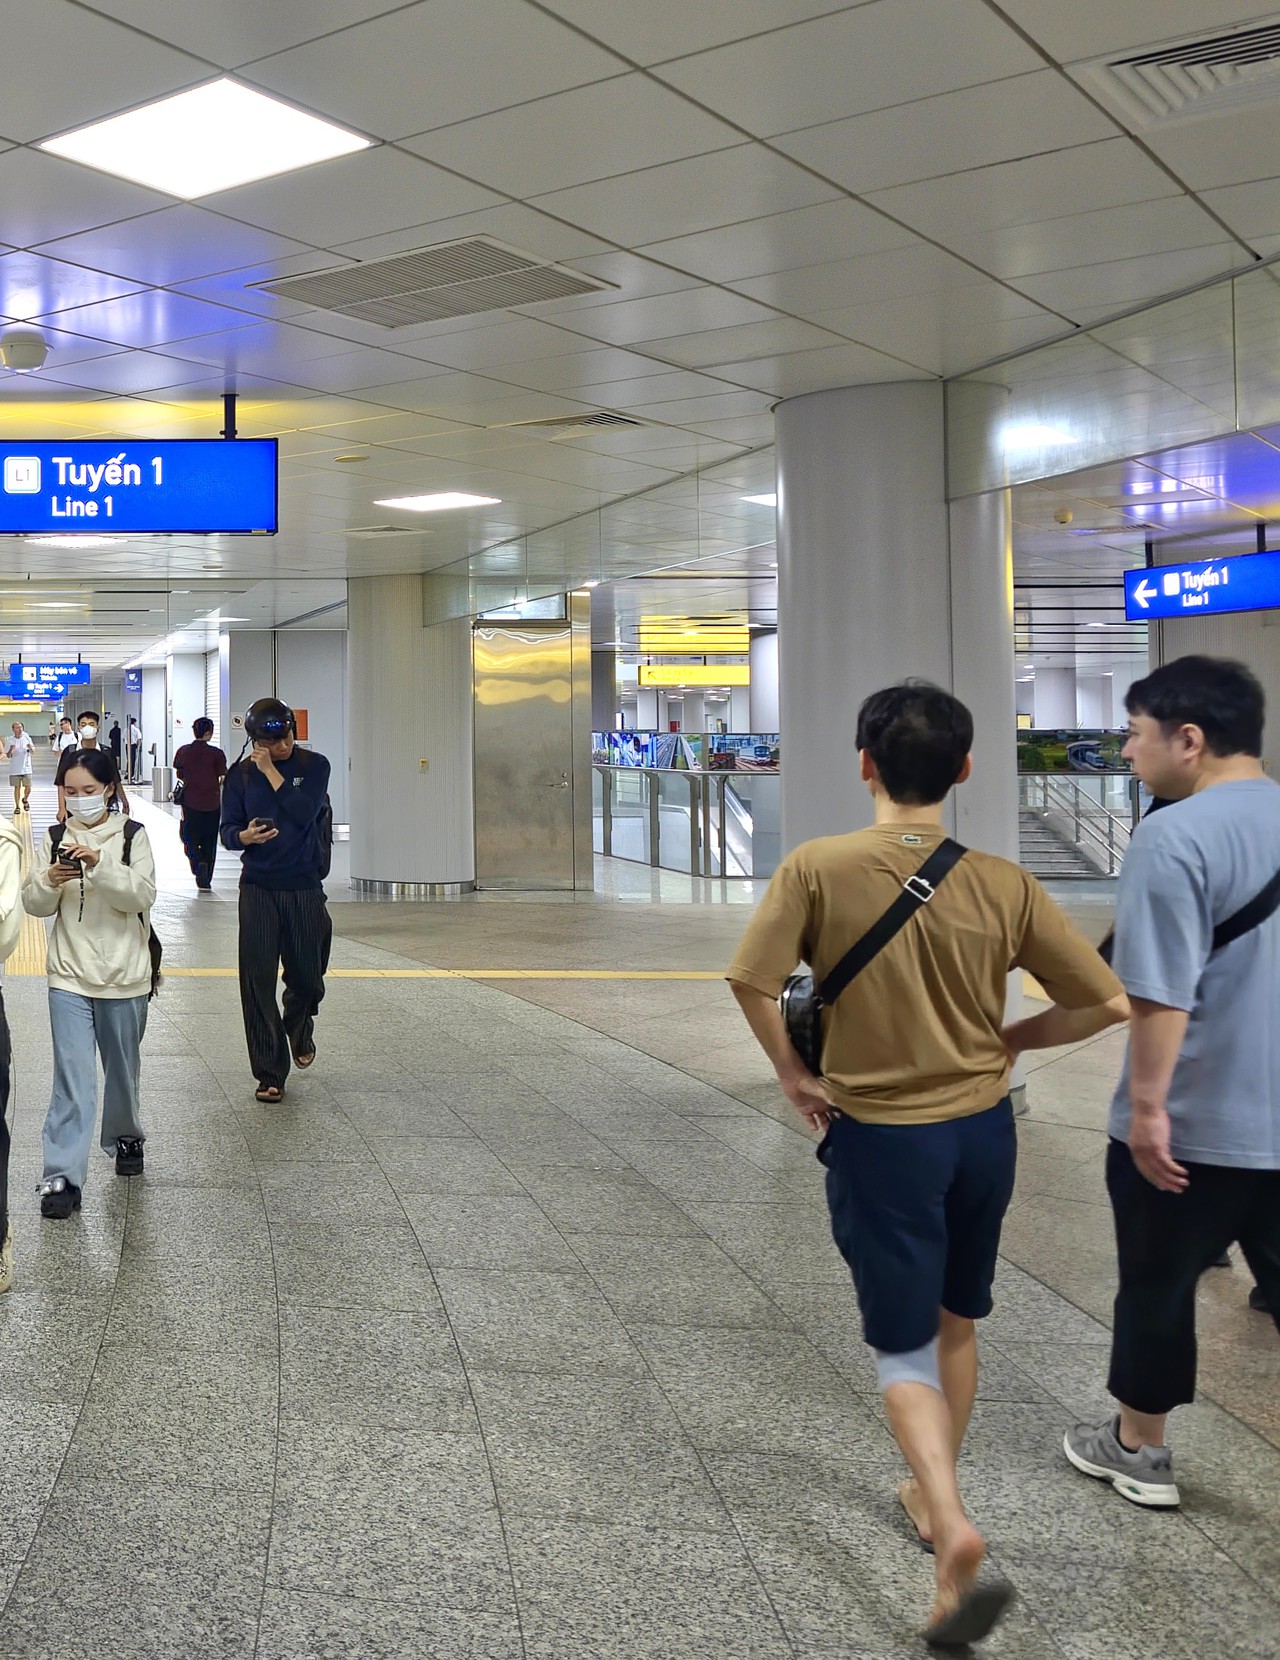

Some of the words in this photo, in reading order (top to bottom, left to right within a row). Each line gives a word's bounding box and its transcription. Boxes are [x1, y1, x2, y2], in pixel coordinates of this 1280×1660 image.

[52, 453, 141, 493] Tuyến
[151, 457, 163, 485] 1
[52, 496, 98, 517] Line
[103, 496, 113, 517] 1
[1181, 566, 1220, 592] Tuyến
[1221, 566, 1228, 585] 1
[1182, 593, 1203, 607] Line
[1203, 591, 1209, 605] 1
